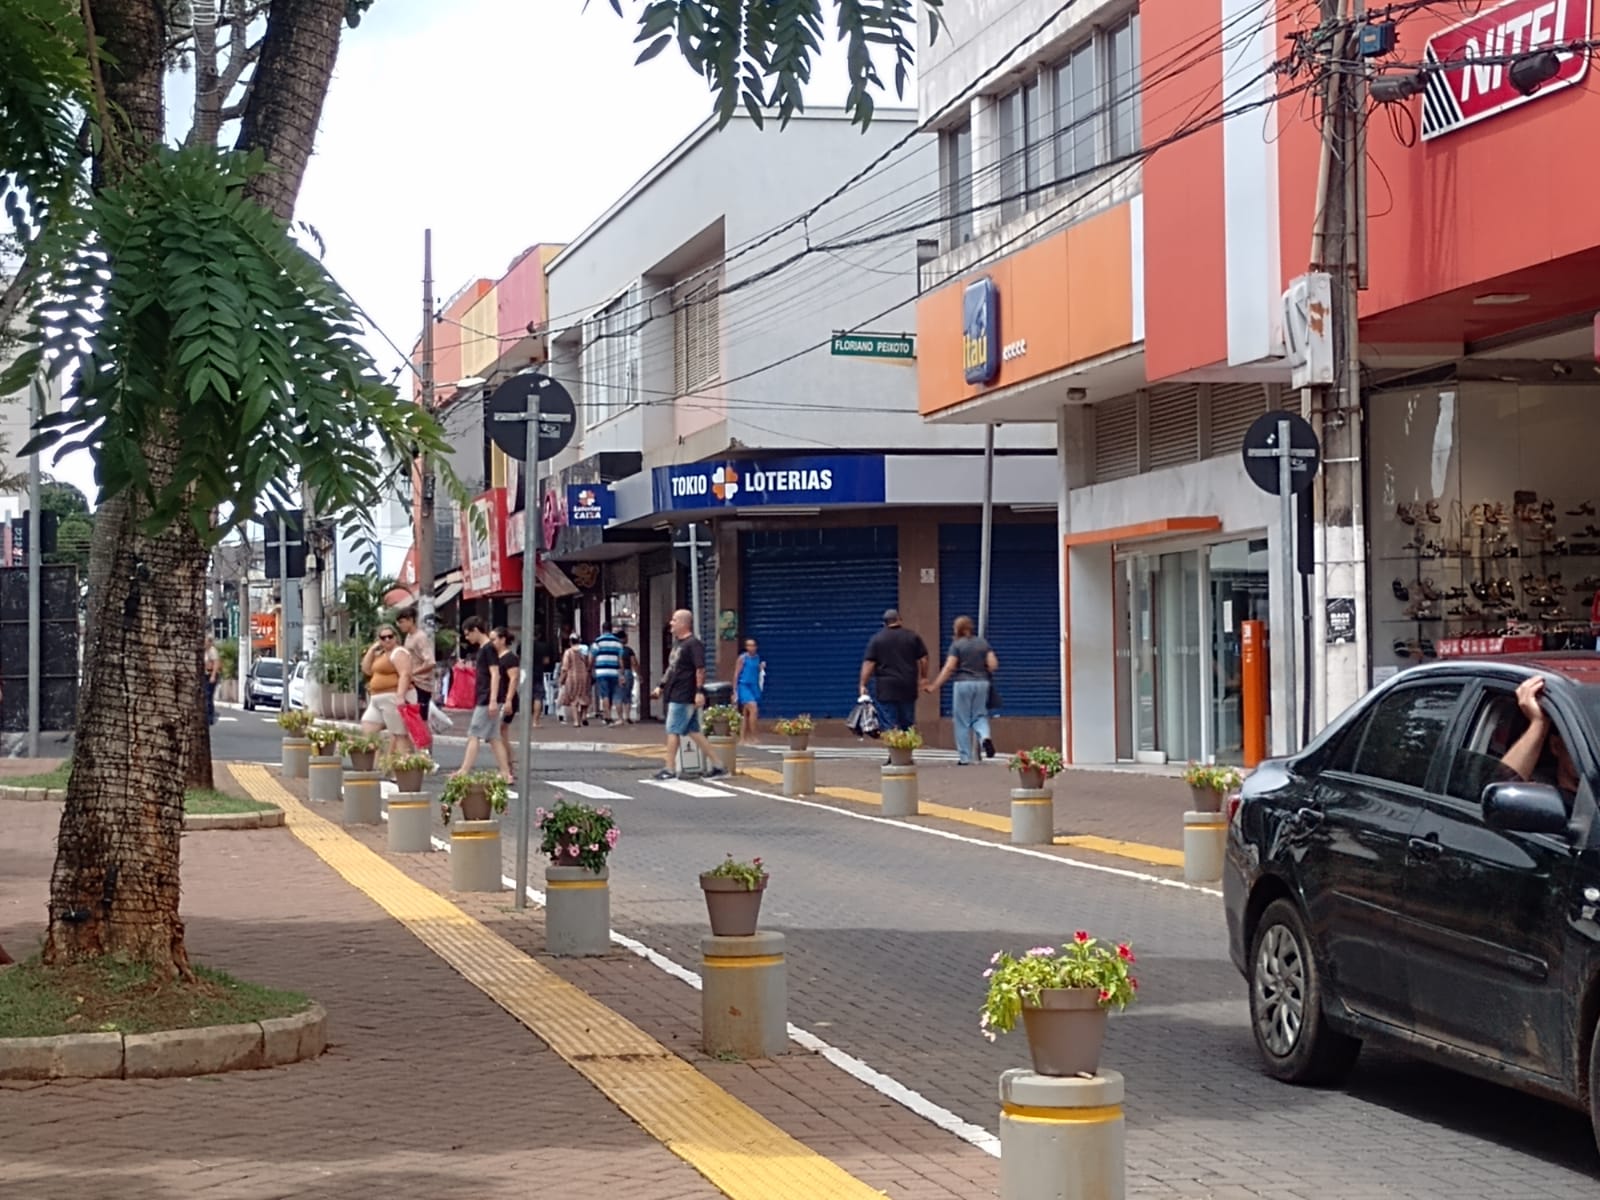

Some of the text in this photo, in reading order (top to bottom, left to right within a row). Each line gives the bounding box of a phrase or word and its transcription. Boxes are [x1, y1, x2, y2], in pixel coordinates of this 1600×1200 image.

[835, 339, 910, 354] FLORIANO PEIXOTO
[672, 469, 832, 496] TOKIO LOTERIAS
[574, 511, 602, 519] CAIXA
